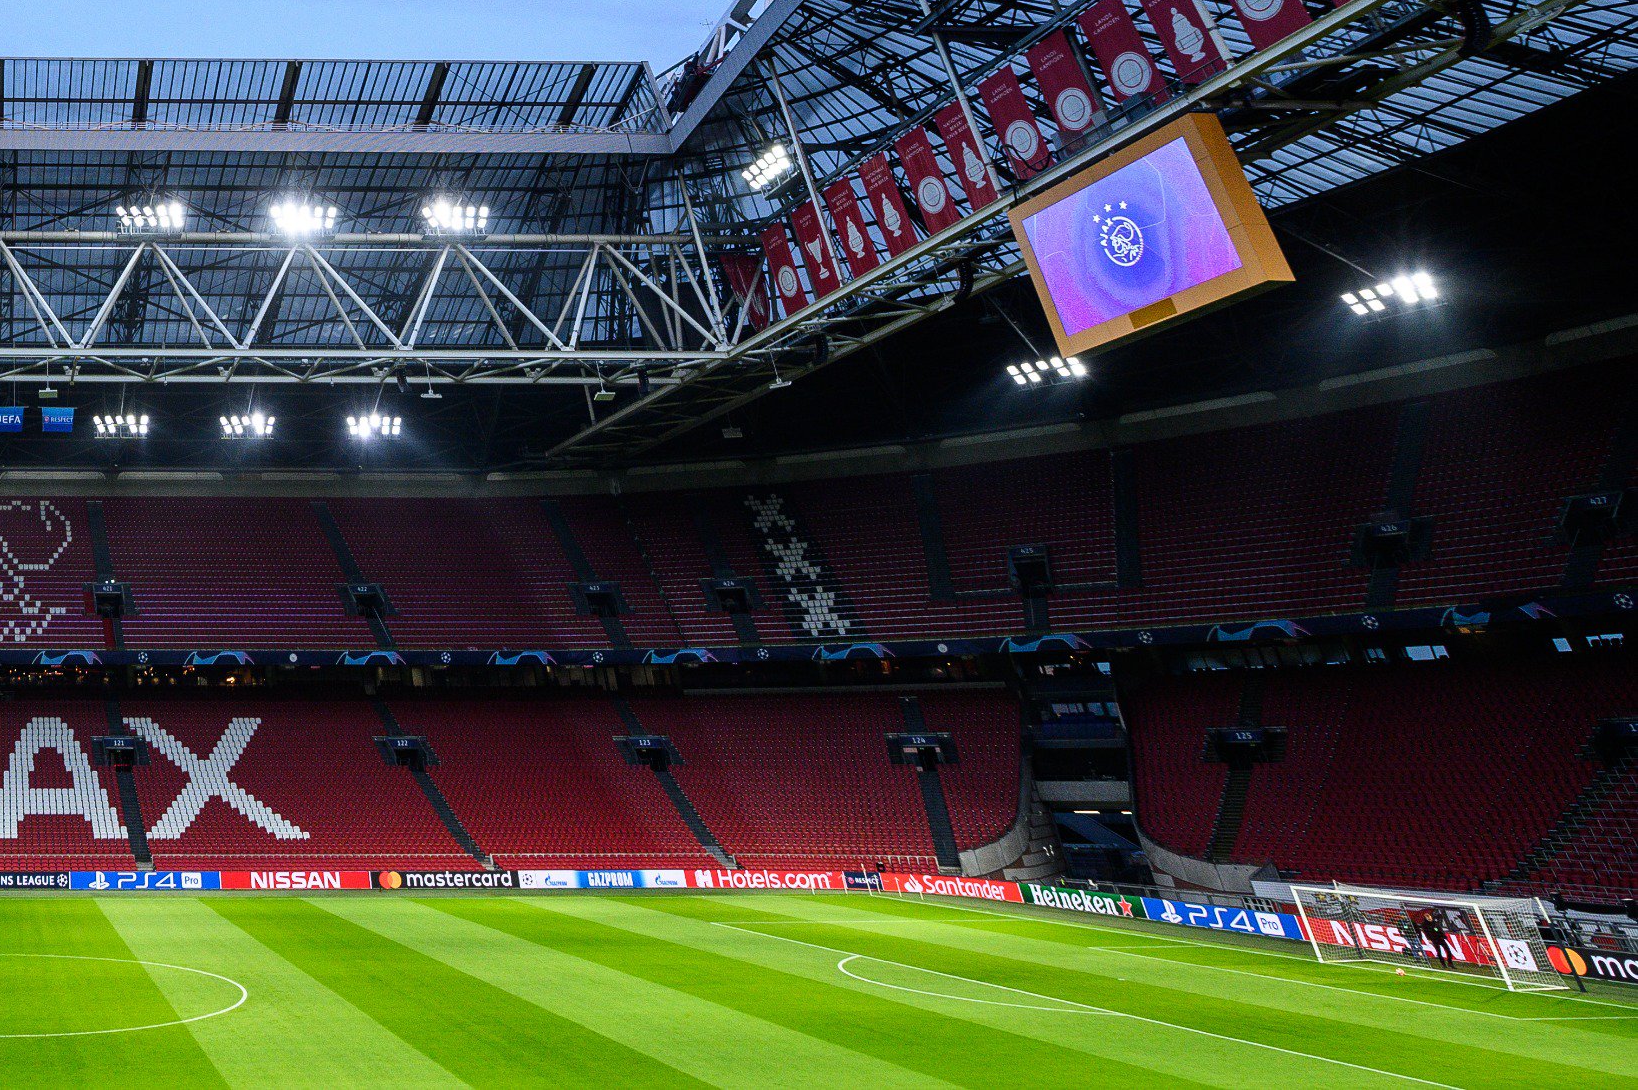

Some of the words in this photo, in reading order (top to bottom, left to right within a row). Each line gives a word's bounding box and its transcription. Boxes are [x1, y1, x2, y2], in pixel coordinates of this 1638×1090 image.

[1094, 12, 1113, 27] LANDS
[1590, 496, 1607, 505] 427
[912, 736, 926, 744] 124
[1235, 732, 1252, 740] 125
[16, 875, 55, 886] LEAGUE
[116, 873, 177, 889] PS4
[184, 875, 199, 886] Pro
[250, 872, 341, 889] NISSAN
[406, 870, 513, 888] mastercard
[587, 871, 634, 887] GAZPROM
[923, 875, 1005, 901] Santander
[1028, 883, 1119, 916] Heineken
[1184, 903, 1255, 932] PS4
[1260, 916, 1279, 930] Pro
